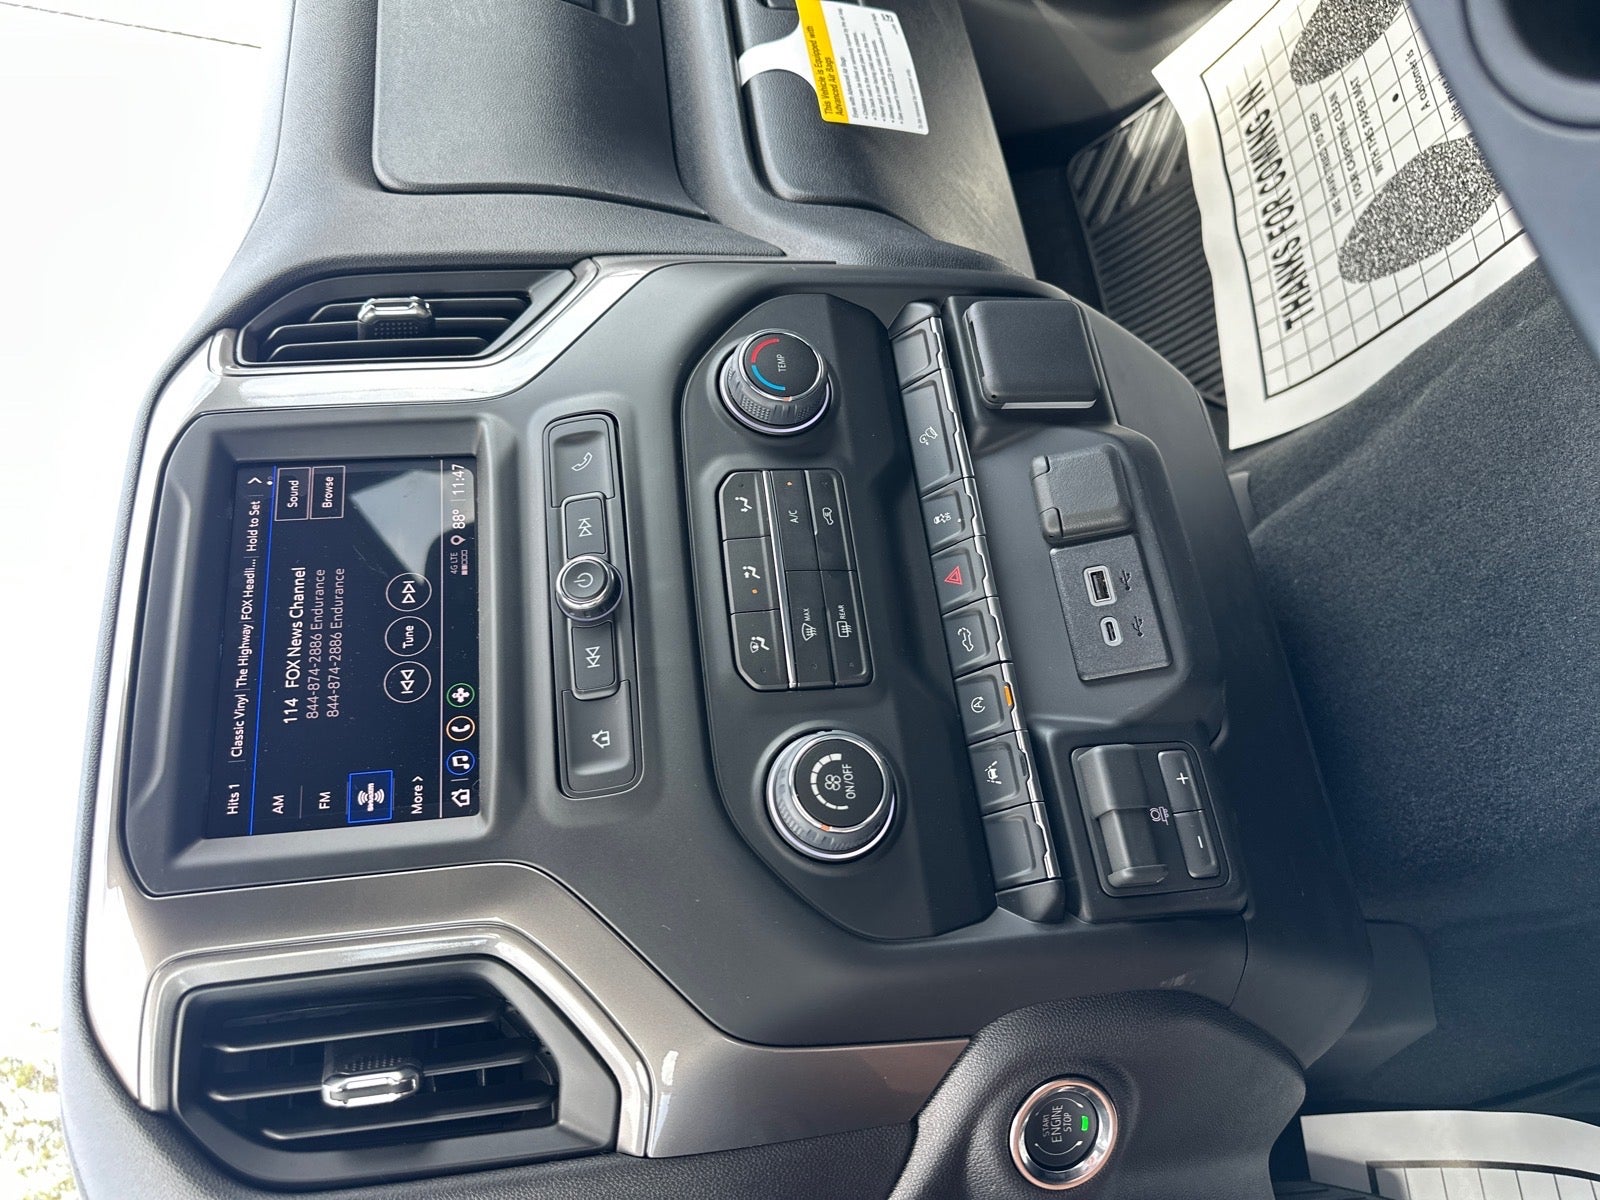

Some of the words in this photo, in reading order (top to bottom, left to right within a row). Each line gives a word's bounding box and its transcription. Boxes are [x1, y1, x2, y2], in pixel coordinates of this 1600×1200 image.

[806, 26, 816, 38] with
[809, 40, 823, 68] Equipped
[824, 57, 835, 72] Bags
[1405, 49, 1414, 62] is
[819, 76, 830, 99] Vehicle
[828, 74, 836, 83] Air
[1350, 76, 1363, 98] MAT
[1408, 59, 1427, 101] customer
[824, 101, 833, 114] This
[831, 84, 844, 116] Advanced
[1236, 80, 1266, 118] IN
[1328, 91, 1343, 122] CLEAN
[1420, 100, 1431, 111] A
[1309, 113, 1322, 132] KEEP
[1354, 96, 1371, 128] PAPER
[1450, 104, 1463, 122] the
[1314, 133, 1326, 149] TO
[1337, 121, 1356, 171] CARPETING
[1364, 127, 1378, 151] THIS
[1244, 108, 1286, 196] COMING
[1319, 147, 1333, 175] TRIED
[1371, 149, 1384, 176] WITH
[1325, 173, 1338, 200] HAVE
[1349, 170, 1363, 200] YOUR
[1261, 188, 1298, 242] FOR
[1332, 198, 1342, 217] WE
[1272, 236, 1314, 331] THANKS
[776, 354, 786, 372] TEMP
[322, 476, 334, 508] Browse
[452, 464, 465, 495] 11:47
[287, 480, 299, 508] Sound
[249, 500, 261, 516] Set
[788, 510, 799, 523] A/C
[248, 518, 259, 527] to
[246, 529, 258, 552] Hold
[450, 552, 458, 564] LTE
[450, 565, 458, 574] 4G
[242, 559, 257, 597] Headli...
[289, 567, 306, 618] Channel
[310, 569, 325, 630] Endurance
[330, 568, 345, 628] Endurance
[241, 599, 253, 620] FOX
[803, 608, 811, 621] MAX
[838, 605, 846, 619] REAR
[236, 624, 254, 666] Highway
[287, 622, 303, 656] News
[402, 625, 414, 648] Tune
[236, 669, 248, 688] The
[285, 660, 301, 688] FOX
[306, 633, 322, 719] 844-874-2886
[327, 632, 342, 717] 844-874-2886
[234, 694, 249, 719] Vinyl
[283, 698, 298, 724] 114
[231, 720, 245, 757] Classic
[842, 764, 856, 799] ON/OFF
[226, 792, 240, 814] Hits
[272, 795, 285, 814] AM
[319, 792, 331, 809] FM
[411, 785, 423, 814] More
[1042, 1114, 1050, 1137] START
[1051, 1105, 1063, 1143] ENGINE
[1063, 1112, 1072, 1132] STOP
